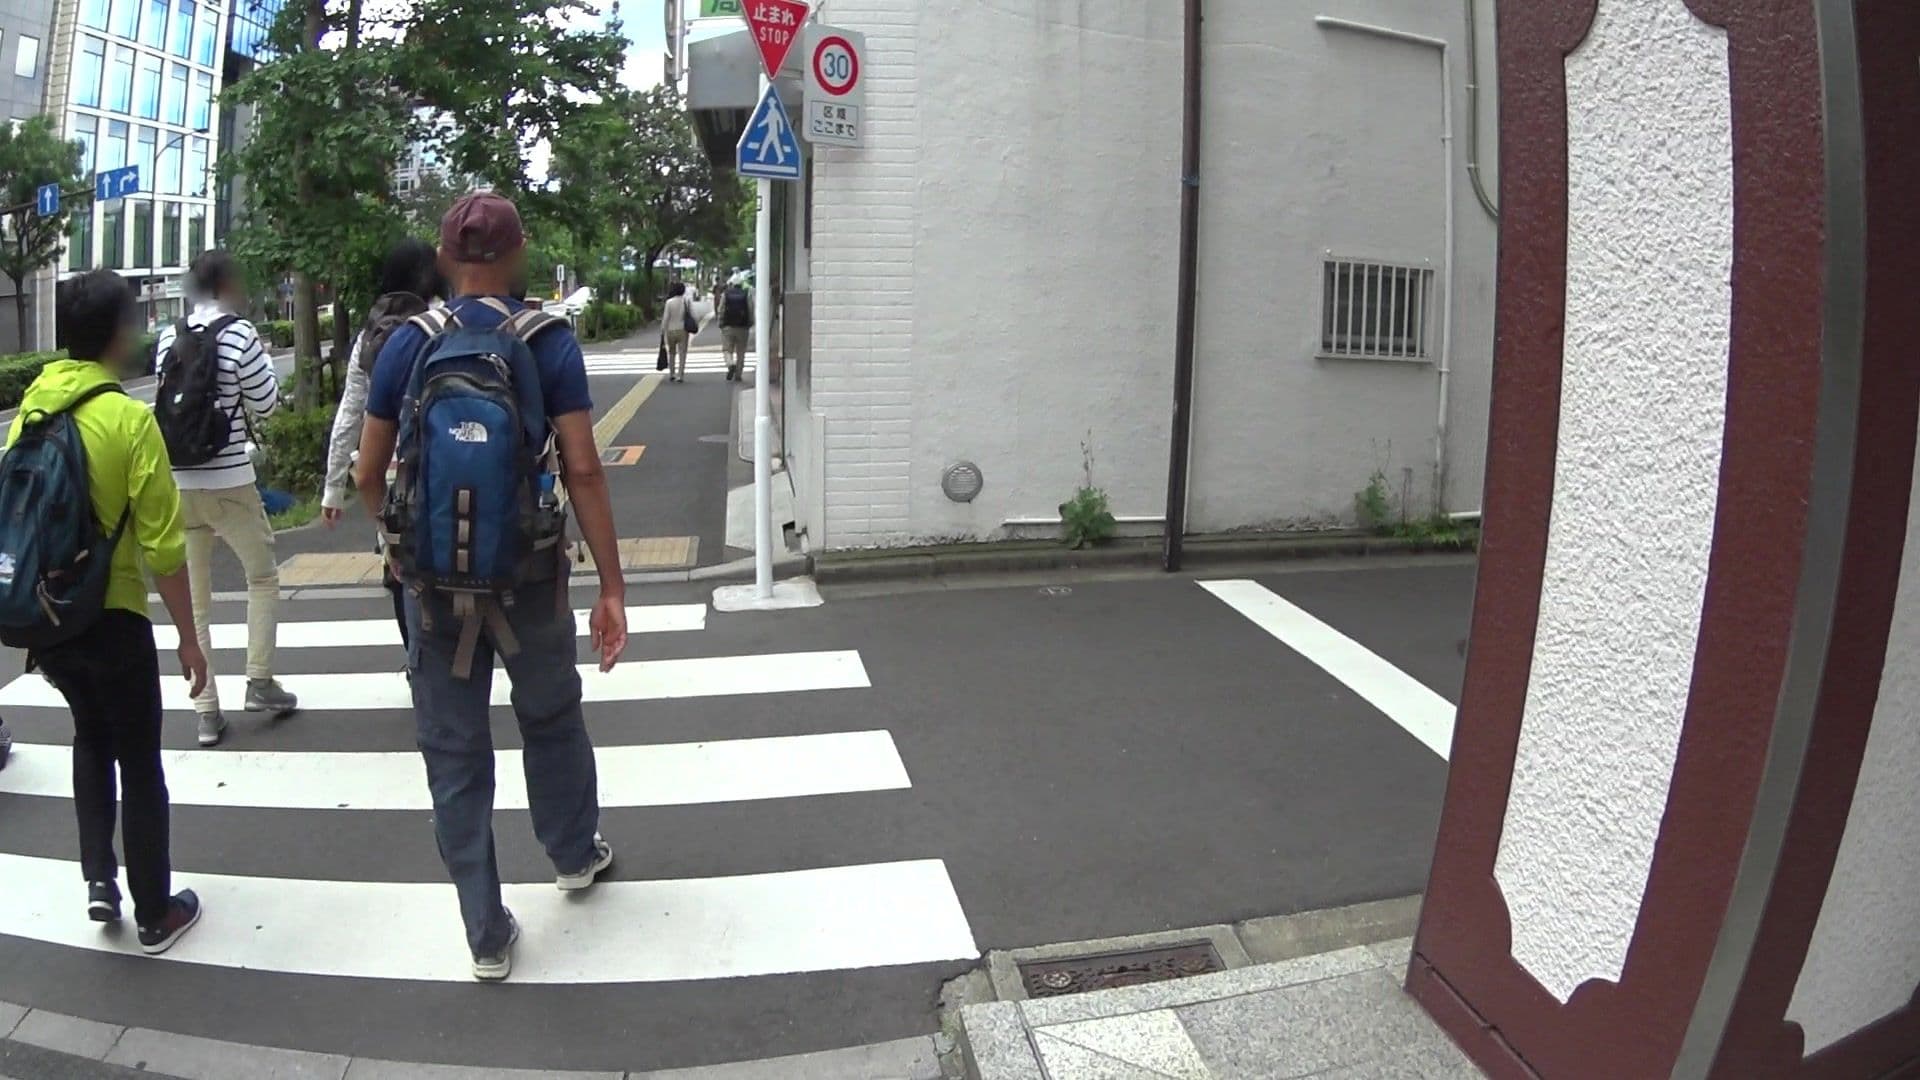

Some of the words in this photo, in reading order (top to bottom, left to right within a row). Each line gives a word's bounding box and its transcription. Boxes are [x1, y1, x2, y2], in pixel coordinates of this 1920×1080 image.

[752, 2, 796, 26] 止まれ
[760, 26, 789, 45] STOP
[824, 52, 849, 80] 30
[813, 119, 855, 137] ここまで
